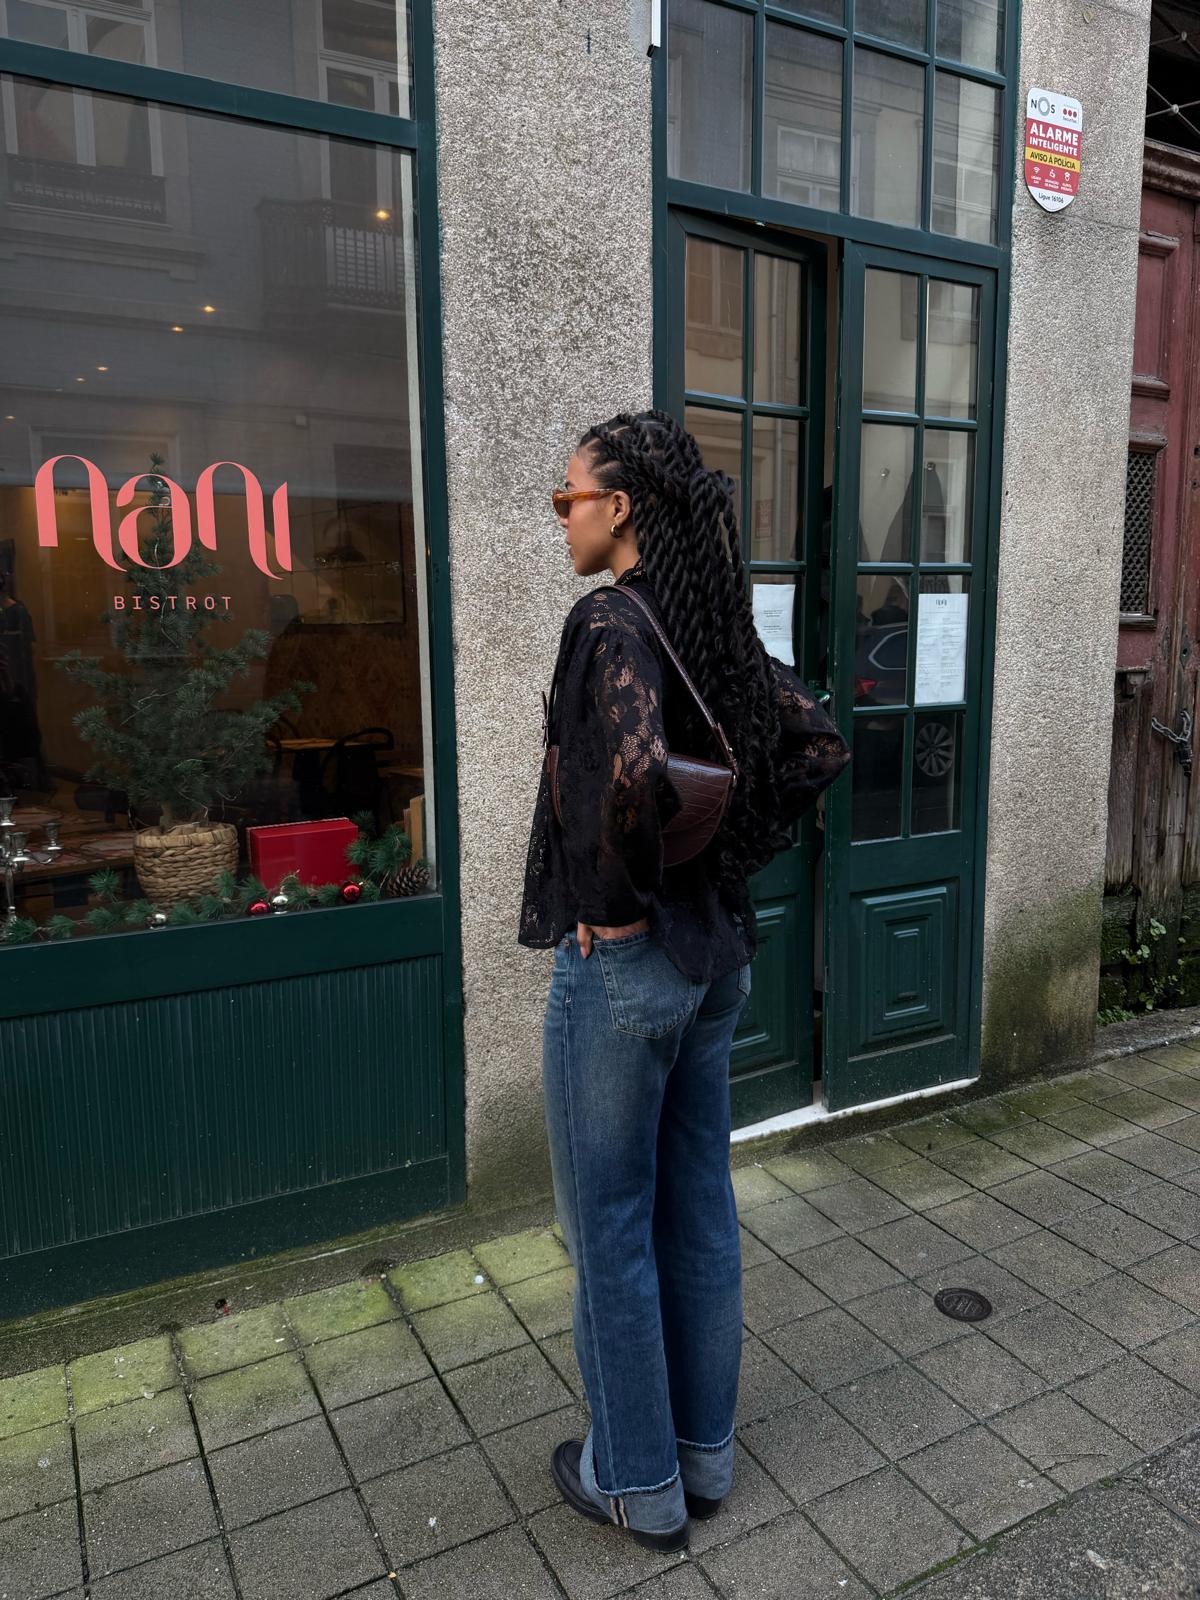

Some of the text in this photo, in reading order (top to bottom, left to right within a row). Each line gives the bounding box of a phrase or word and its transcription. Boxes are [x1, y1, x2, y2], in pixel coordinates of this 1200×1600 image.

[1031, 96, 1056, 116] NOS
[1030, 122, 1079, 146] ALARME
[1029, 136, 1078, 157] INTELIGENTE
[1030, 151, 1076, 170] AVISO À POLÍCIA
[1038, 192, 1050, 201] Ligue
[113, 595, 232, 610] BISTROT
